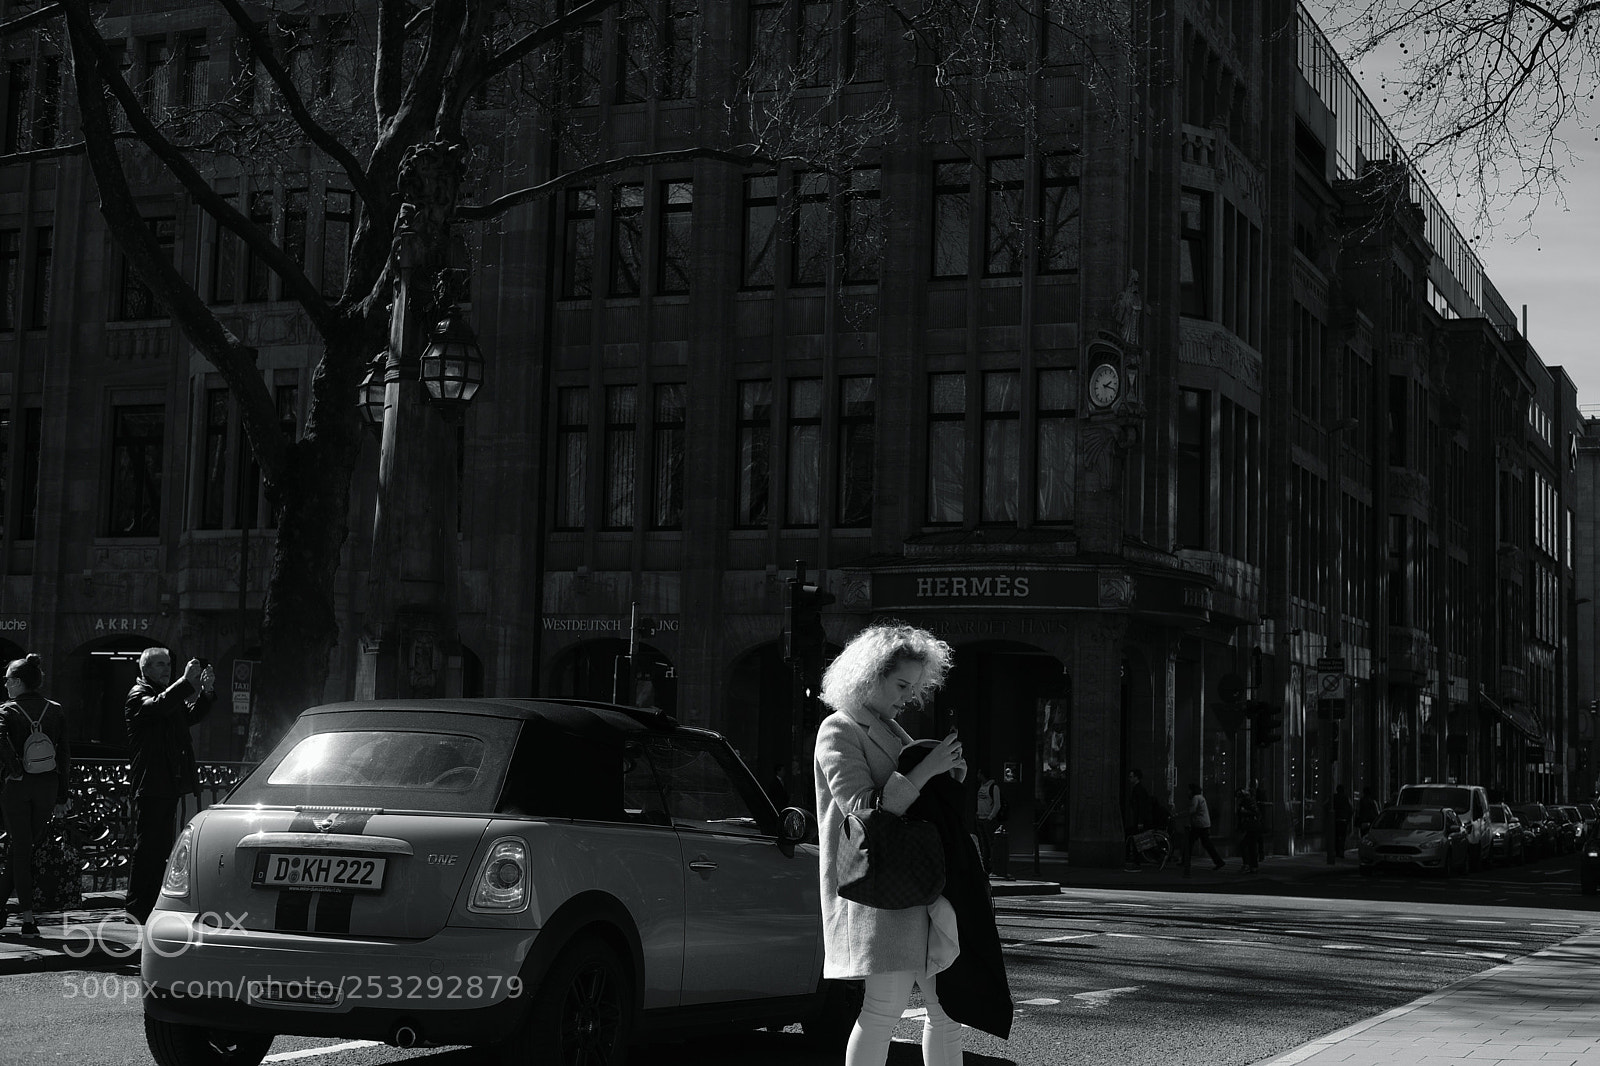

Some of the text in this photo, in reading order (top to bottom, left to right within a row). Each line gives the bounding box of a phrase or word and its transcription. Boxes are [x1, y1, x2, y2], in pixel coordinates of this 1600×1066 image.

[916, 575, 1030, 597] HERMÈS
[95, 618, 149, 630] AKRIS
[427, 854, 459, 866] ONE
[274, 857, 375, 885] D KH 222
